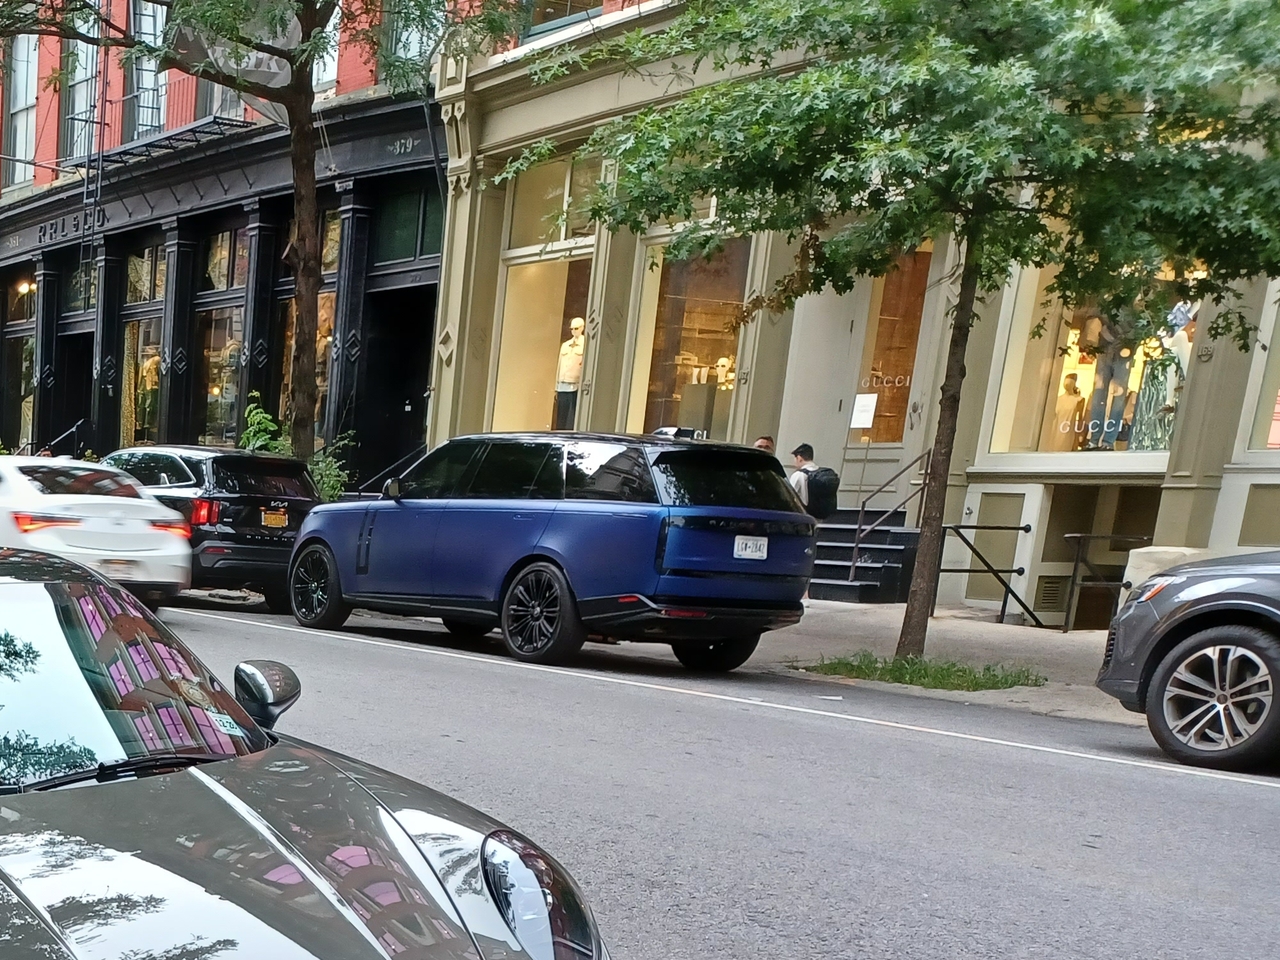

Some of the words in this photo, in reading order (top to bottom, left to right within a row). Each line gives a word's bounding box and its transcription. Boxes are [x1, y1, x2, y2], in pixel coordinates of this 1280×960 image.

[394, 137, 413, 155] 379
[861, 375, 911, 388] GUCCI
[1060, 419, 1123, 433] GUCCI
